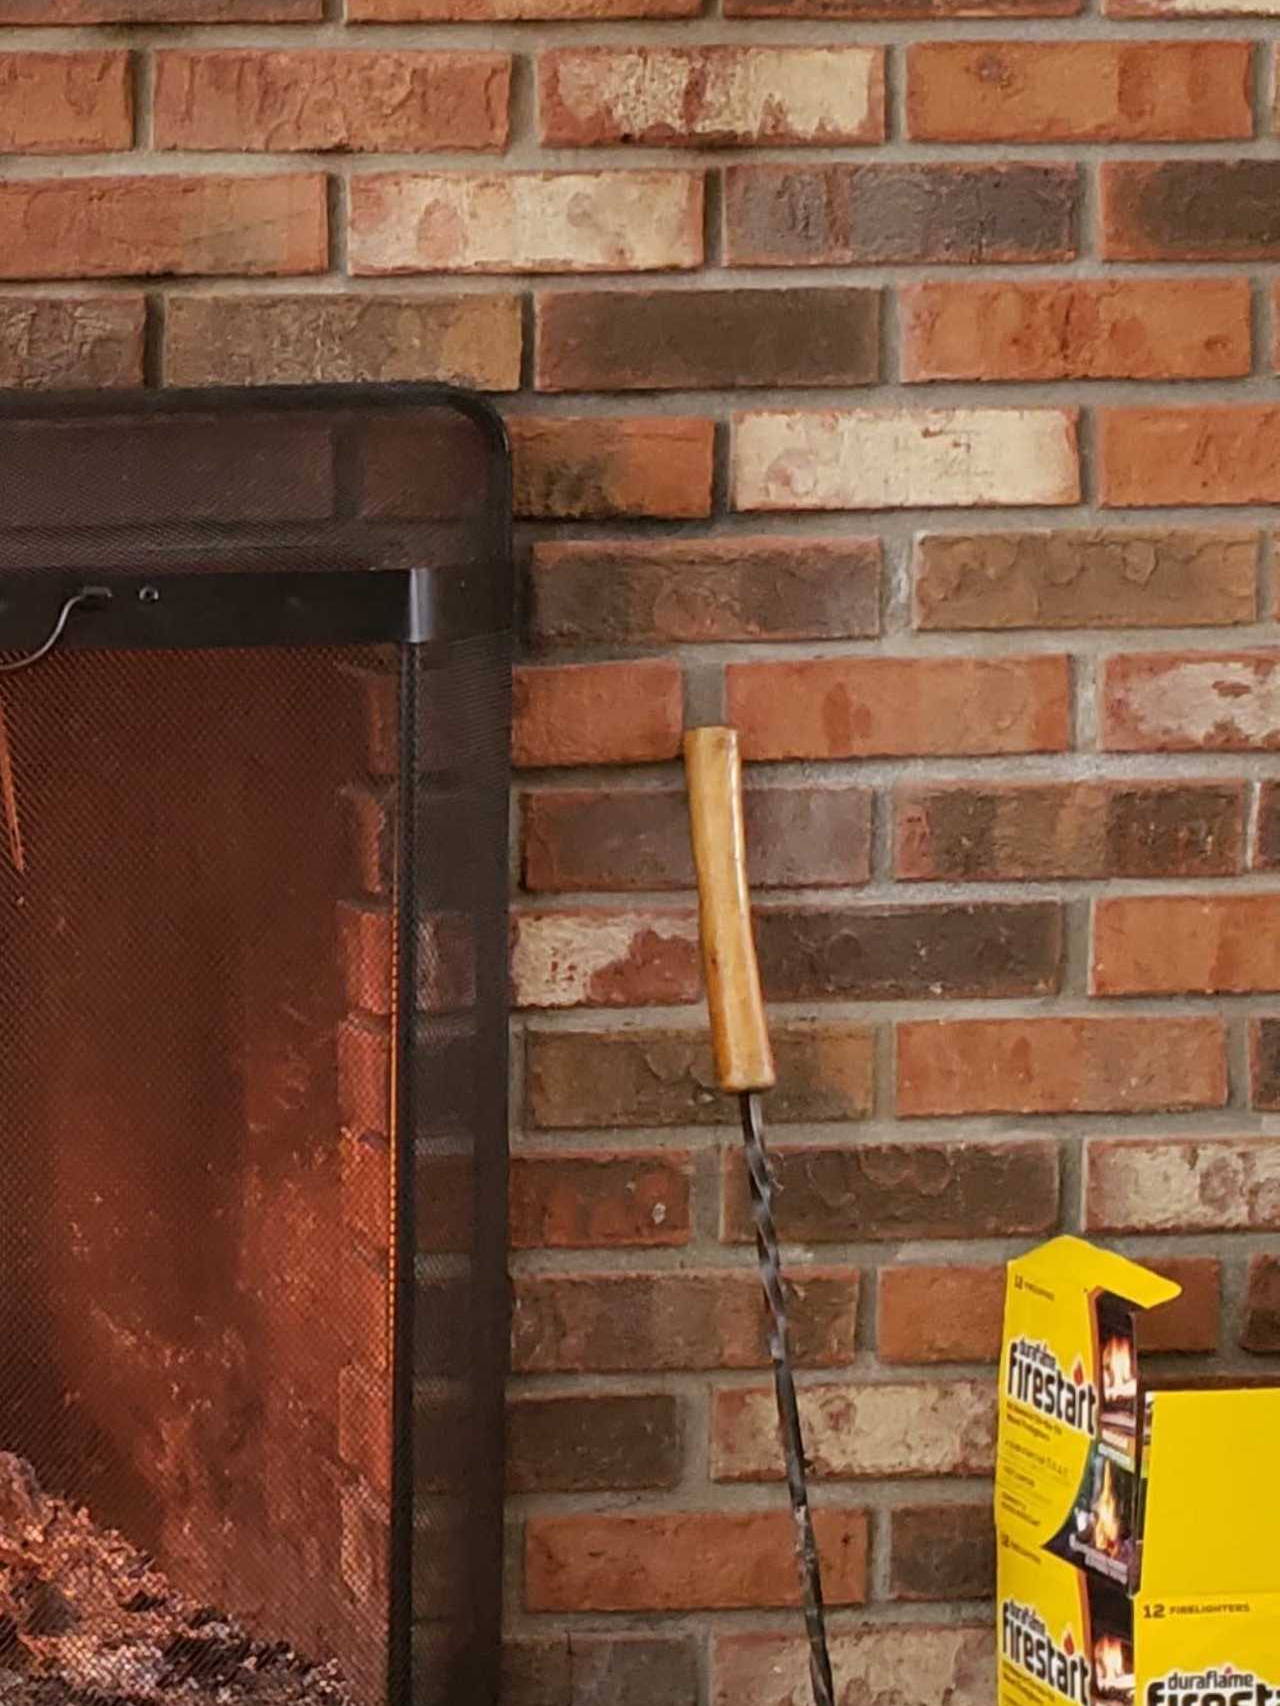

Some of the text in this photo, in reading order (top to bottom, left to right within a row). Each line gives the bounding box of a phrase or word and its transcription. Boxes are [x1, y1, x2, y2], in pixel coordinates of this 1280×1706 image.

[1007, 1341, 1097, 1436] firestart
[1143, 1603, 1250, 1619] 12 FIRELIGHTERS
[1002, 1601, 1089, 1706] firestart
[1167, 1669, 1254, 1690] duraflame
